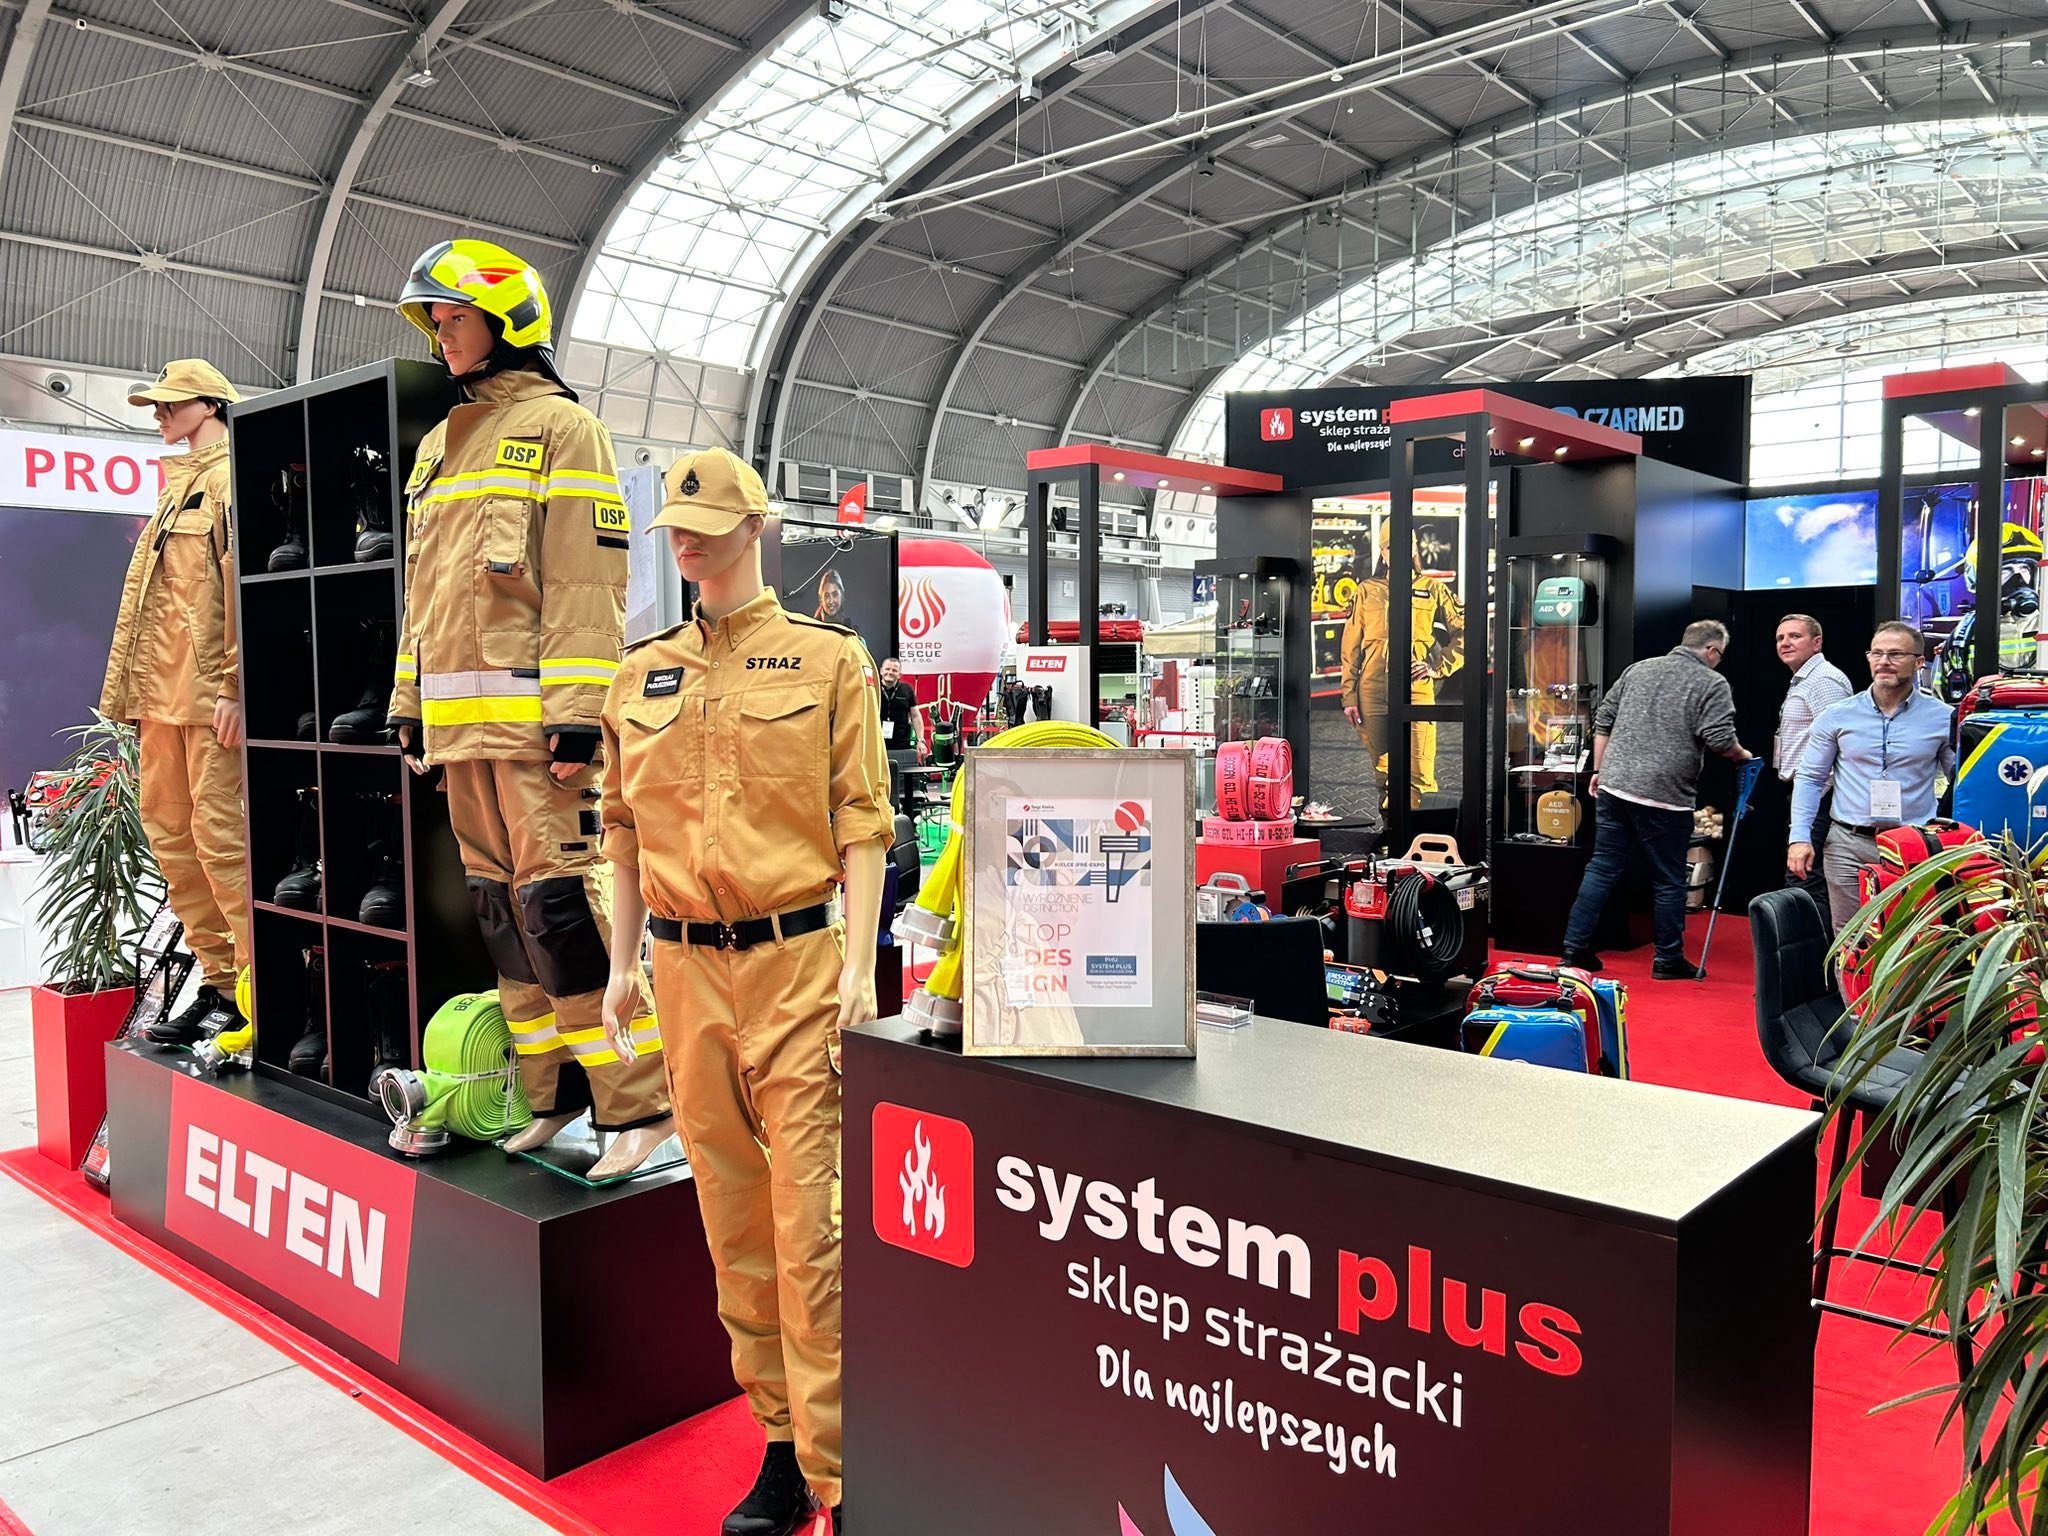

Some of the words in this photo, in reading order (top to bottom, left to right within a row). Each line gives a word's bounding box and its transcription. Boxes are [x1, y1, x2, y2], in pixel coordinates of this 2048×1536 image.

[1300, 406, 1377, 426] system
[1583, 406, 1684, 432] CZARMED
[1319, 427, 1351, 438] sklep
[1353, 424, 1391, 435] straża
[502, 445, 537, 464] OSP
[1327, 441, 1342, 452] Dla
[600, 506, 626, 525] OSP
[1196, 579, 1208, 597] 4
[1539, 605, 1554, 613] AED
[899, 642, 942, 650] EKORD
[899, 650, 942, 658] ESCUE
[1029, 658, 1063, 669] ELTEN
[1221, 826, 1234, 840] GIL
[1023, 923, 1071, 942] TOP
[1024, 948, 1072, 967] DES
[1024, 974, 1068, 992] IGN
[184, 1123, 387, 1299] ELTEN
[995, 1155, 1311, 1300] system
[1337, 1244, 1583, 1377] plus
[1067, 1256, 1190, 1341] sklep
[1205, 1306, 1463, 1428] strażacki
[1095, 1344, 1155, 1401] Dla
[1165, 1377, 1397, 1479] najlepszych
